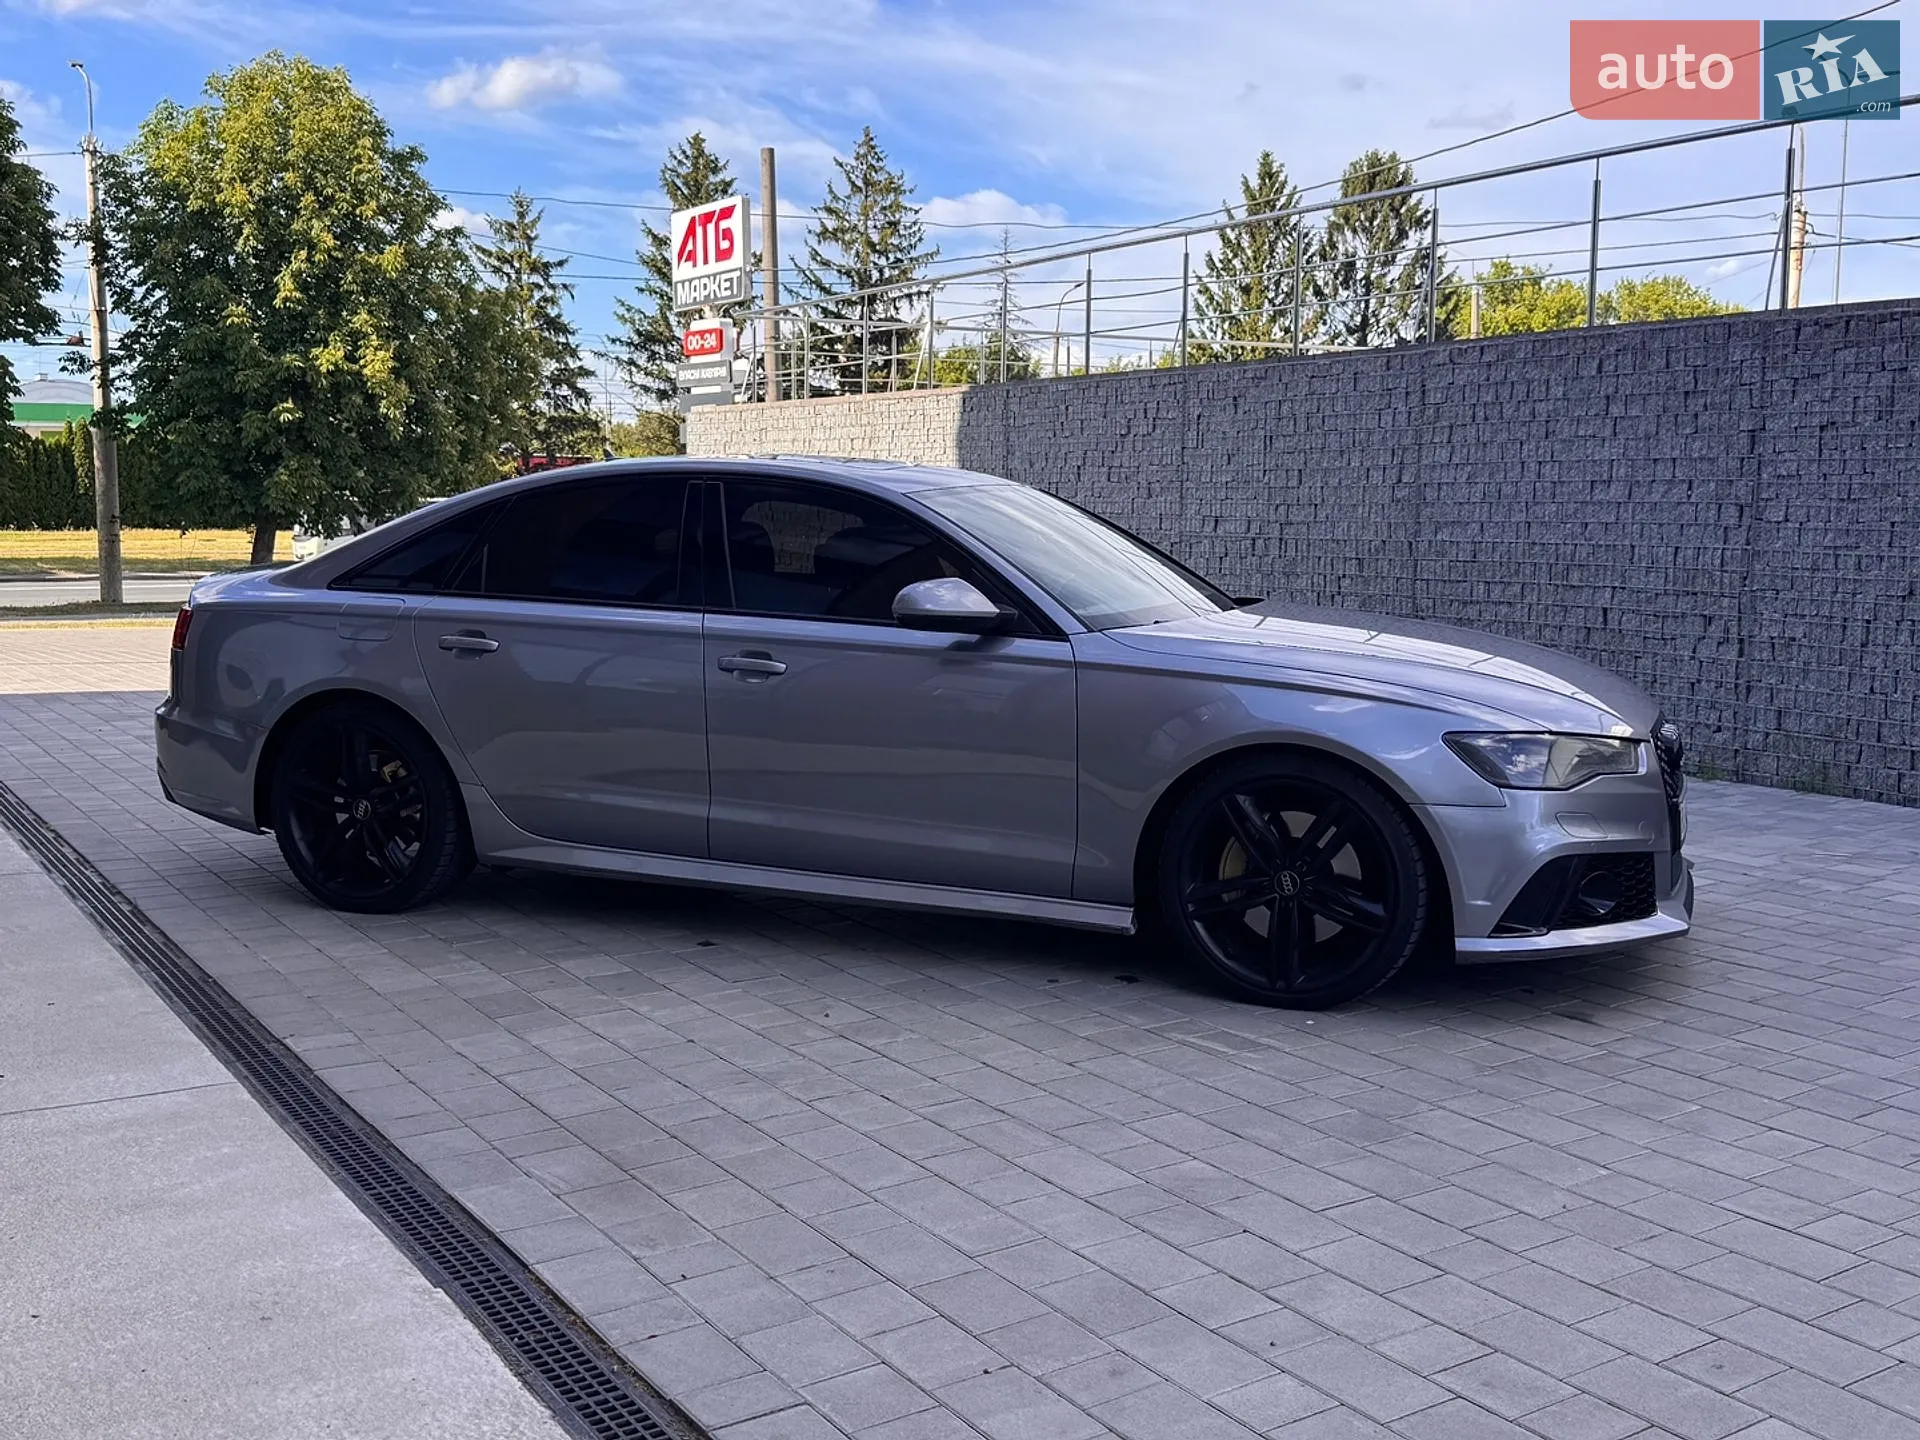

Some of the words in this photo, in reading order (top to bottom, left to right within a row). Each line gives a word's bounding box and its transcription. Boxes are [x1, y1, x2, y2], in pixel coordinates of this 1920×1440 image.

[676, 204, 737, 270] АТБ
[676, 270, 741, 305] МАРКЕТ
[687, 332, 717, 351] 00-24
